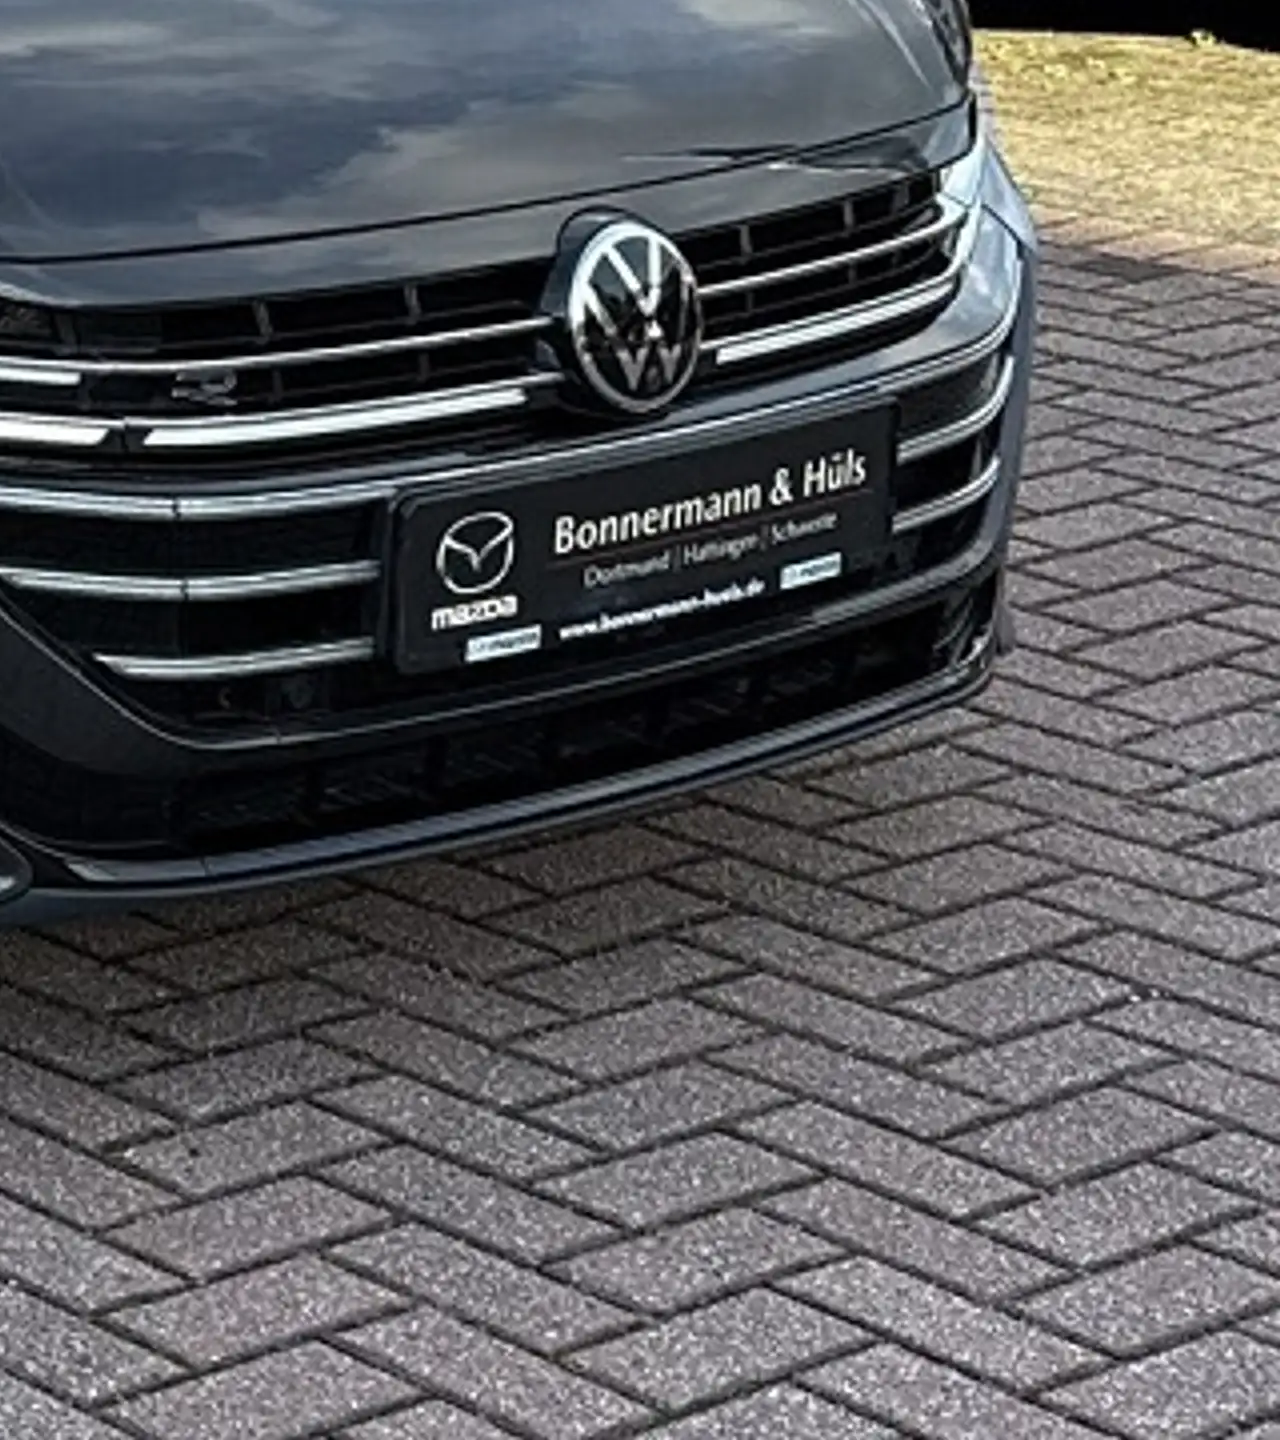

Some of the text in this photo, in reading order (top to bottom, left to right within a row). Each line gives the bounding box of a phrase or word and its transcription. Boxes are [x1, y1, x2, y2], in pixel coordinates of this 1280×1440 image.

[554, 448, 867, 554] Bonnermann & Hüls
[583, 548, 670, 588] Dortmund
